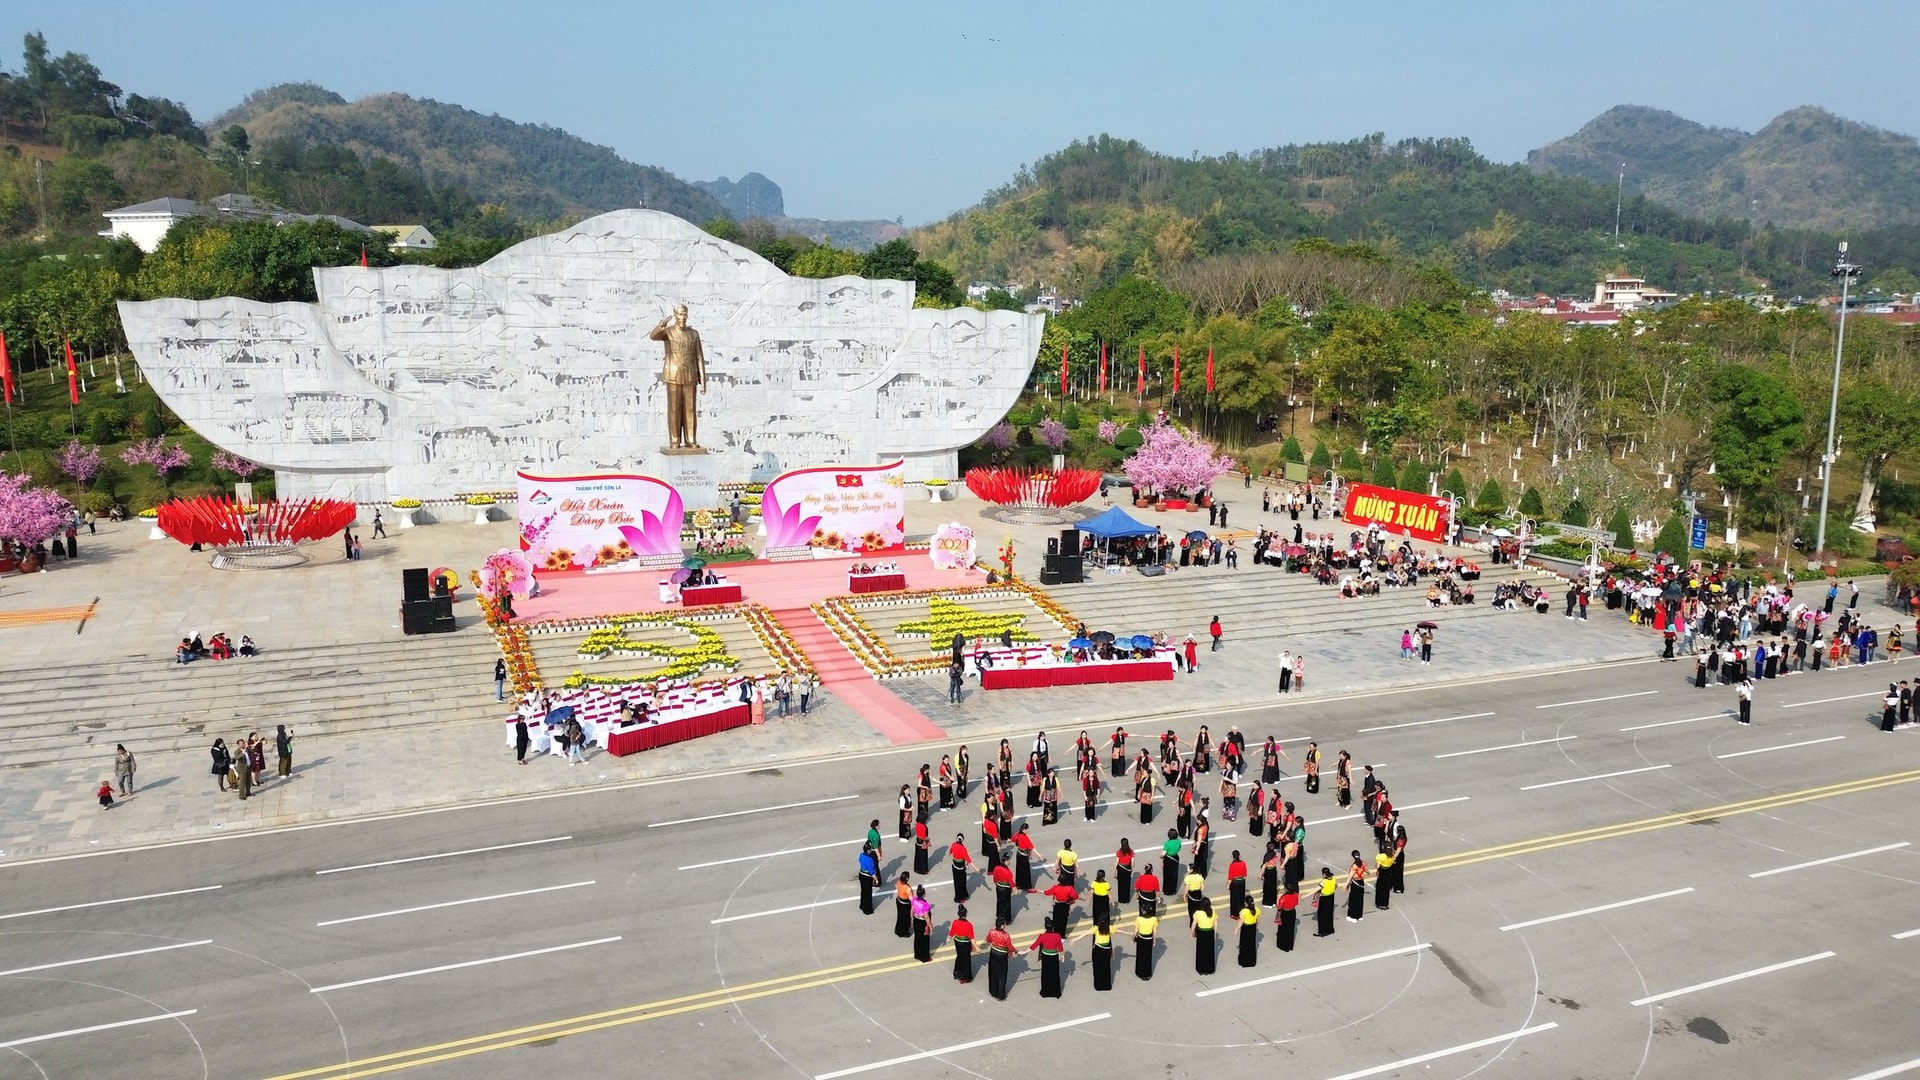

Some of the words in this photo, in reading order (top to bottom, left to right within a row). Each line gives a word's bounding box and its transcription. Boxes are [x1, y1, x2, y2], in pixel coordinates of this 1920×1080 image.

[560, 498, 586, 513] Hội
[587, 498, 624, 511] Xuân
[1353, 494, 1396, 523] MỪNG
[1394, 504, 1439, 532] XUÂN
[608, 511, 635, 524] Bác
